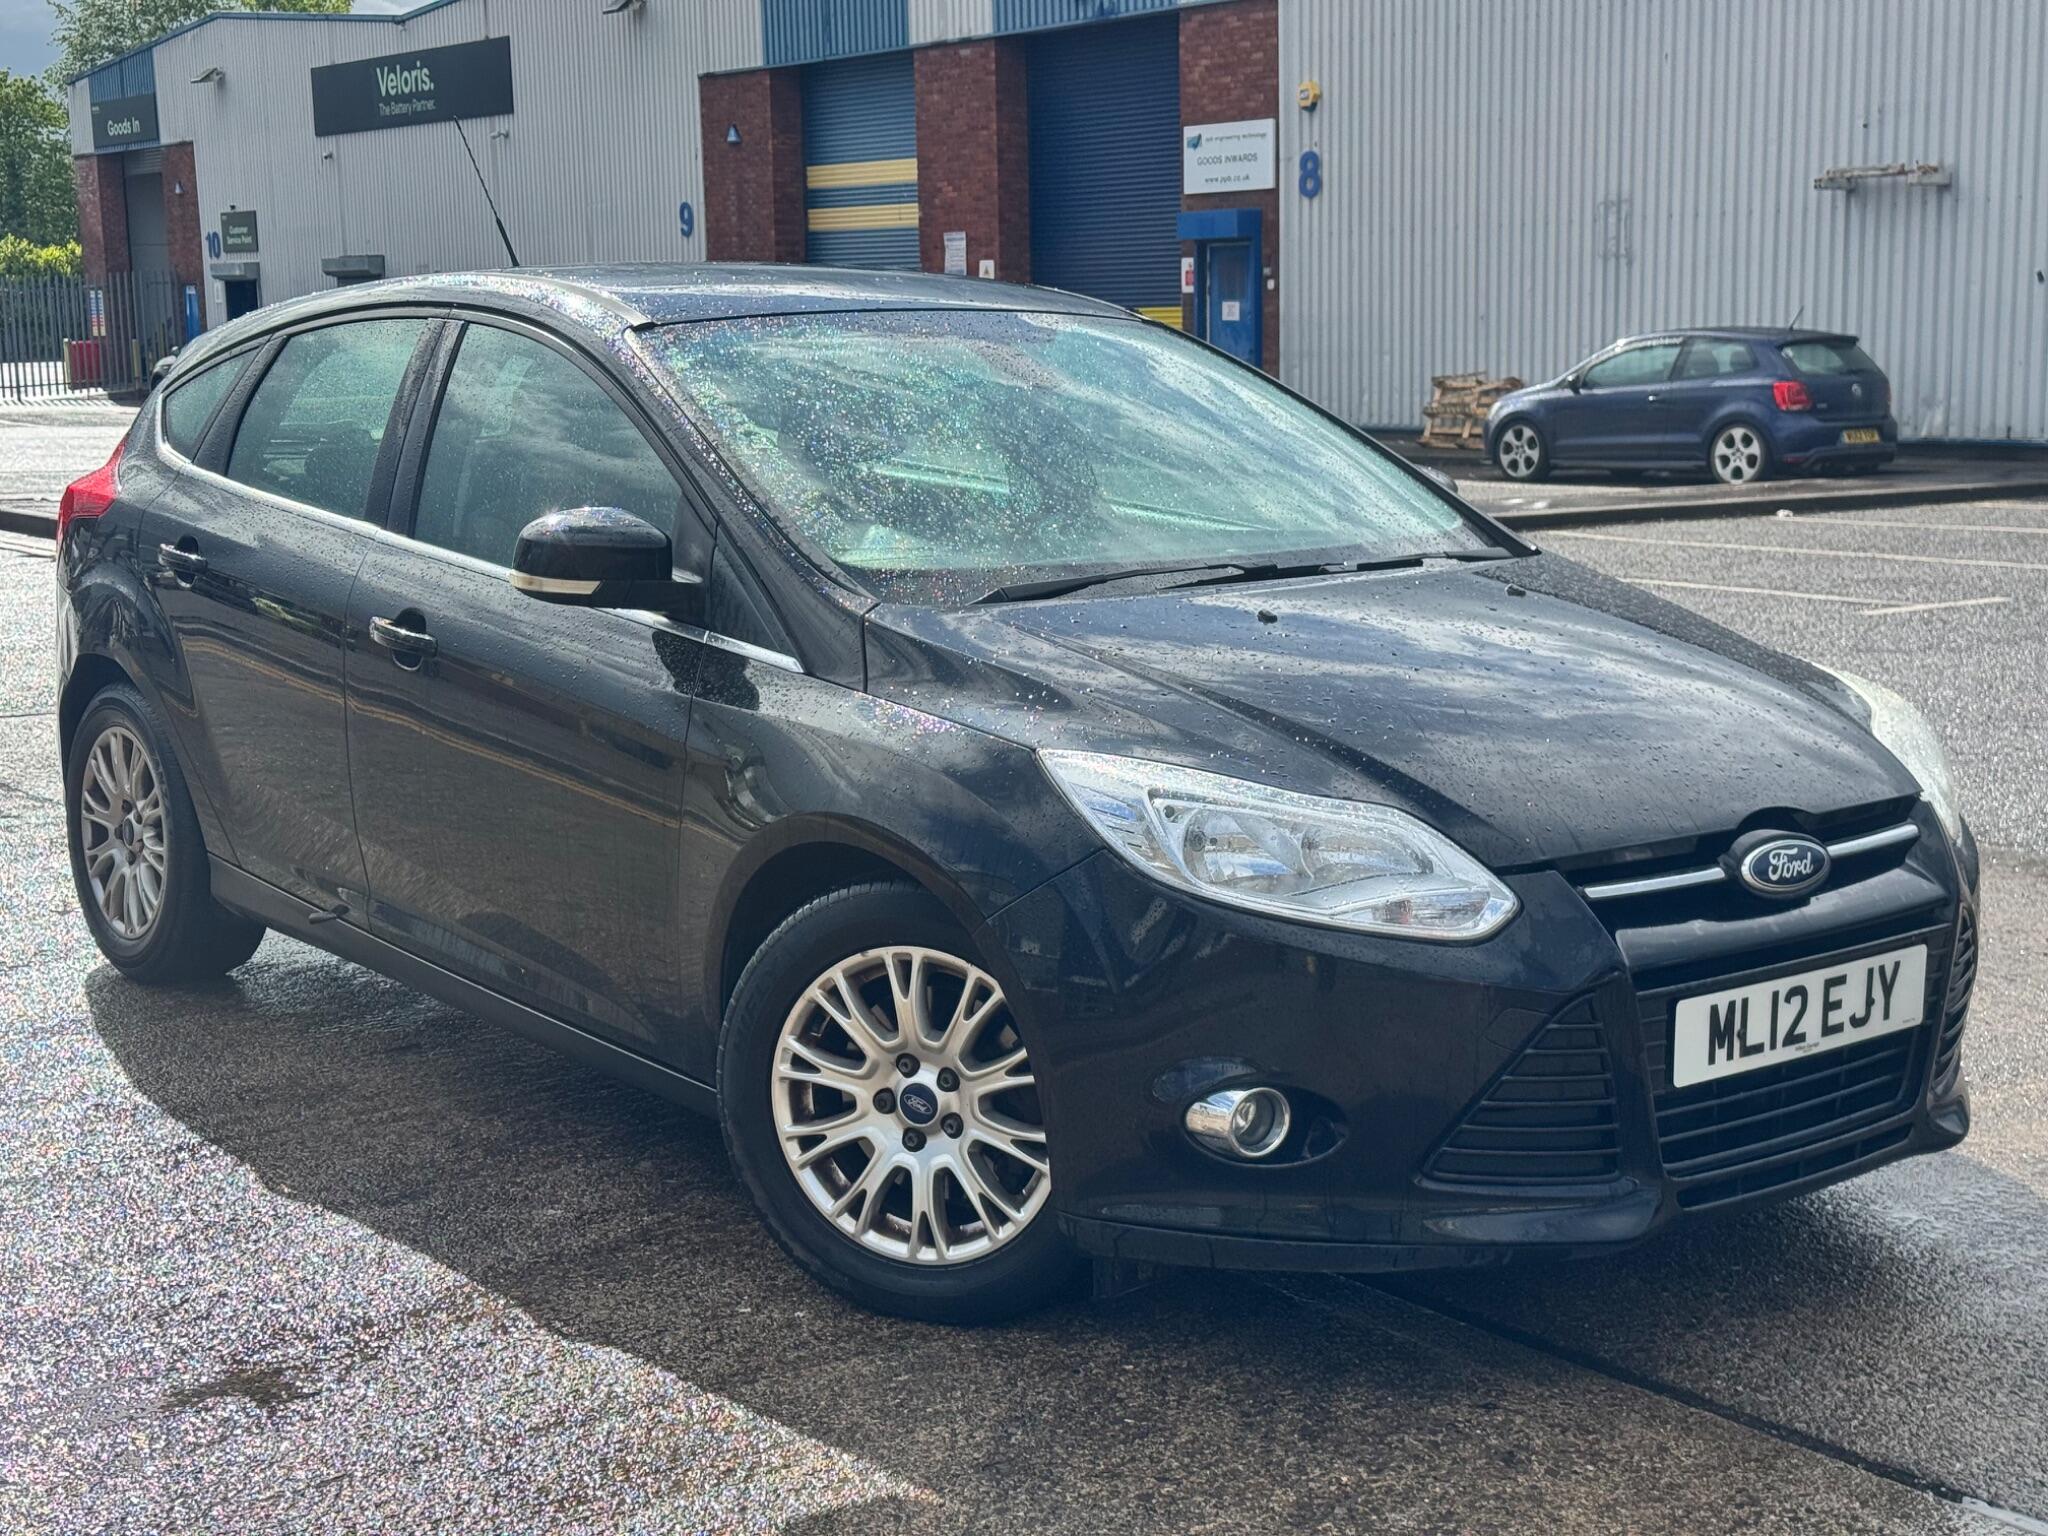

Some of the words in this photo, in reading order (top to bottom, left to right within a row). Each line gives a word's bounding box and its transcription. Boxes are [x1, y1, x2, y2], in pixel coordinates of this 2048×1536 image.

[376, 60, 435, 97] Veloris.
[107, 117, 132, 136] Goods
[131, 116, 141, 133] In
[1197, 154, 1223, 166] GOODS
[1224, 152, 1258, 164] INWARDS
[1299, 151, 1321, 199] 8
[679, 201, 694, 238] 9
[205, 231, 221, 259] 10
[1768, 847, 1814, 881] Ford
[1708, 984, 1809, 1066] ML12
[1821, 960, 1901, 1038] EJY
